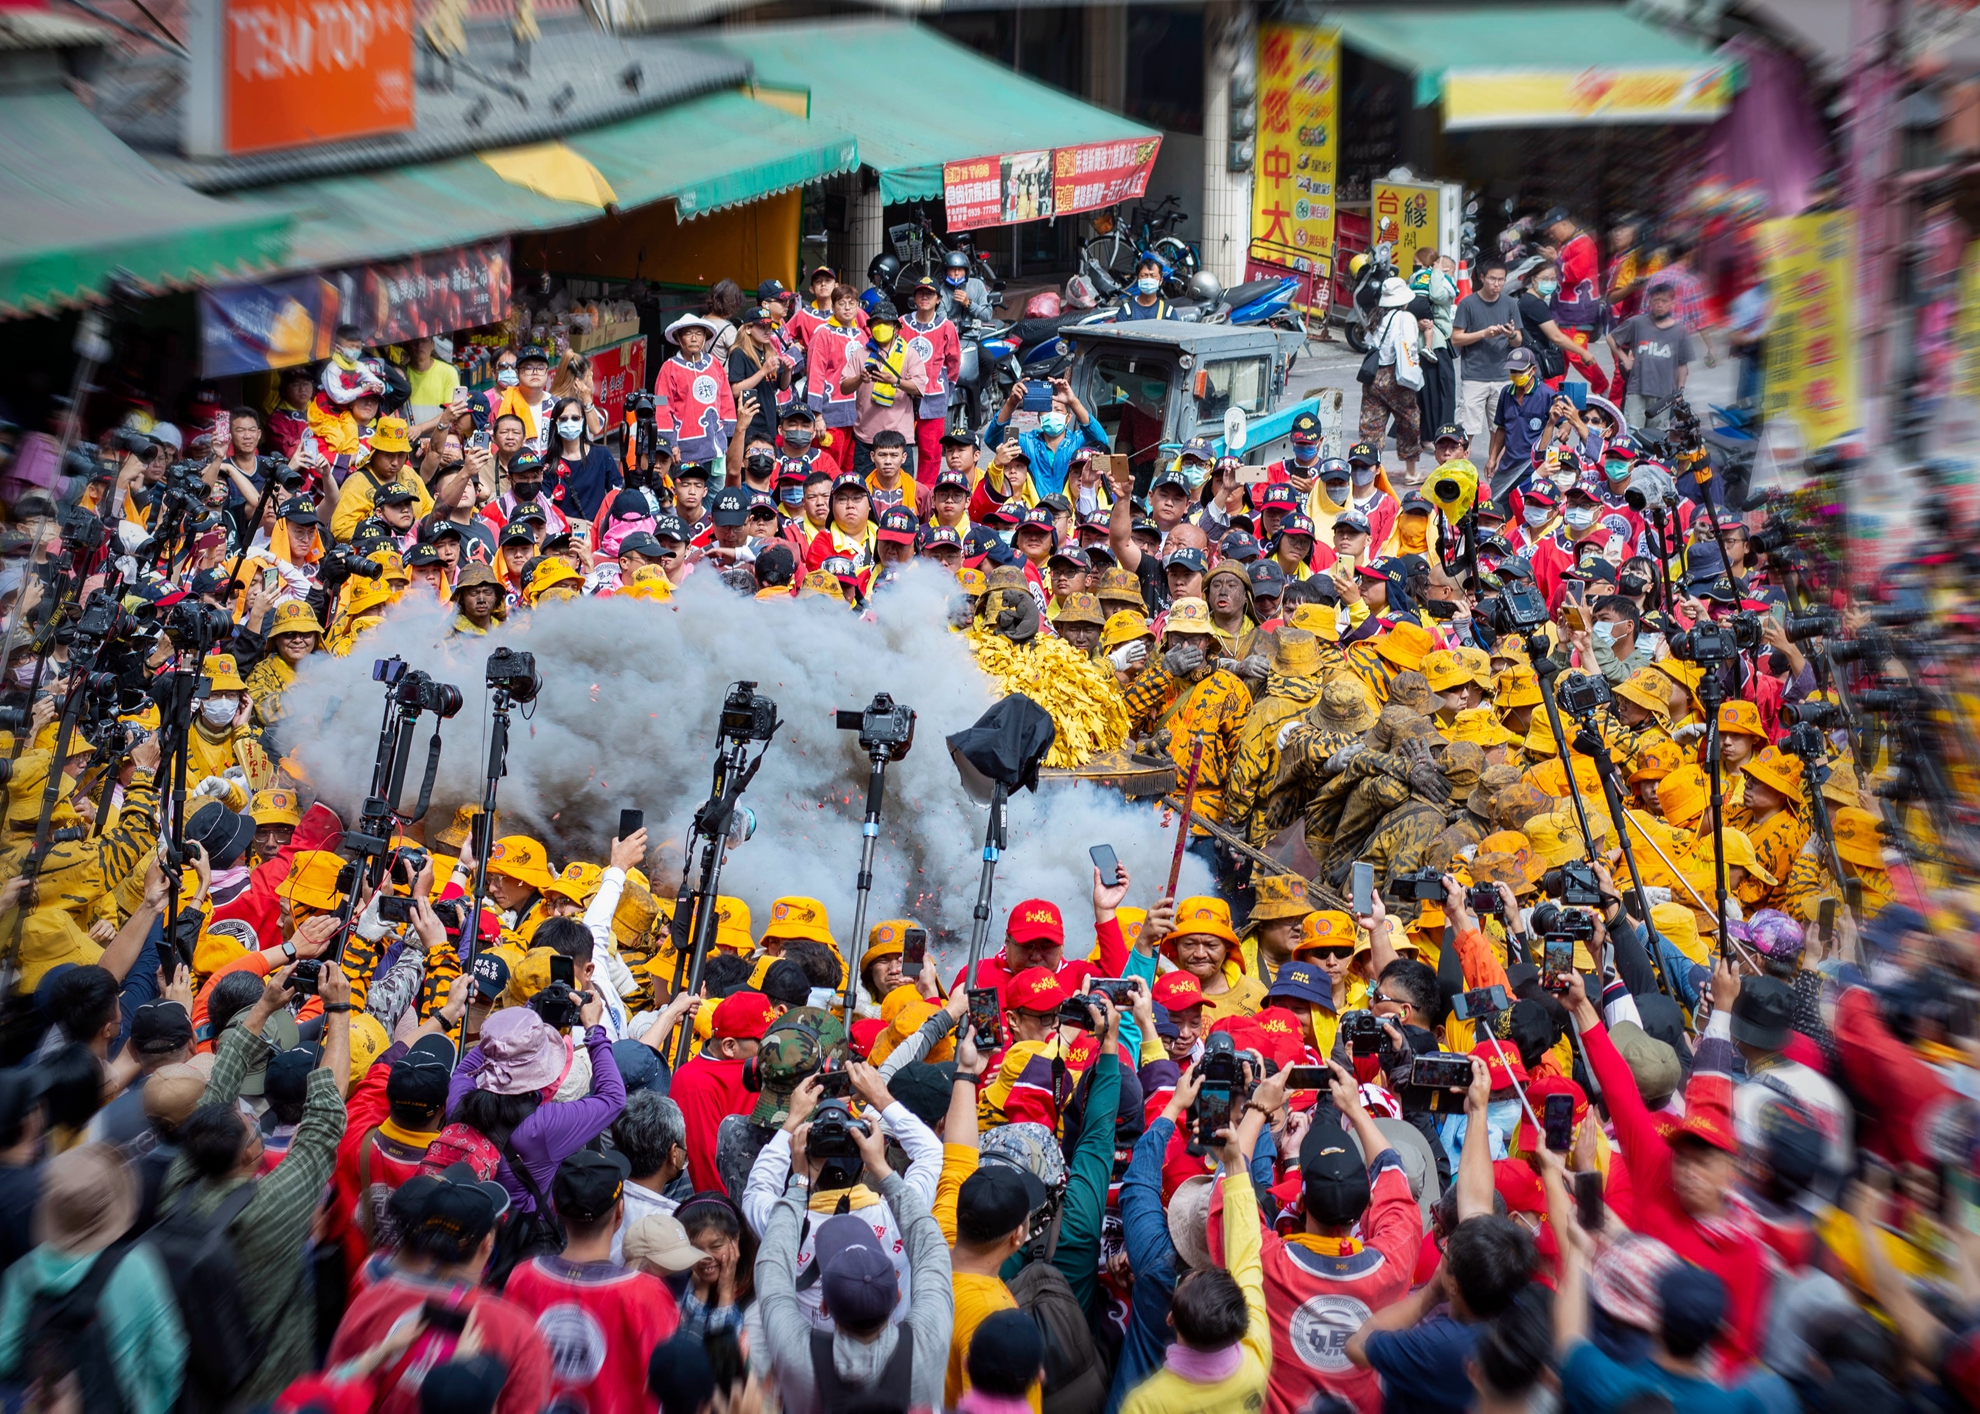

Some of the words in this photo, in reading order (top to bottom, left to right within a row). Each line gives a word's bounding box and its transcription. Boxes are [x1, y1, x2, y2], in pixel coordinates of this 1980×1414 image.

[969, 164, 990, 179] TVBS
[945, 179, 1001, 207] 食尚玩家推薦
[453, 265, 488, 292] 新品上市
[1311, 279, 1330, 309] 車
[1637, 341, 1672, 359] FILA
